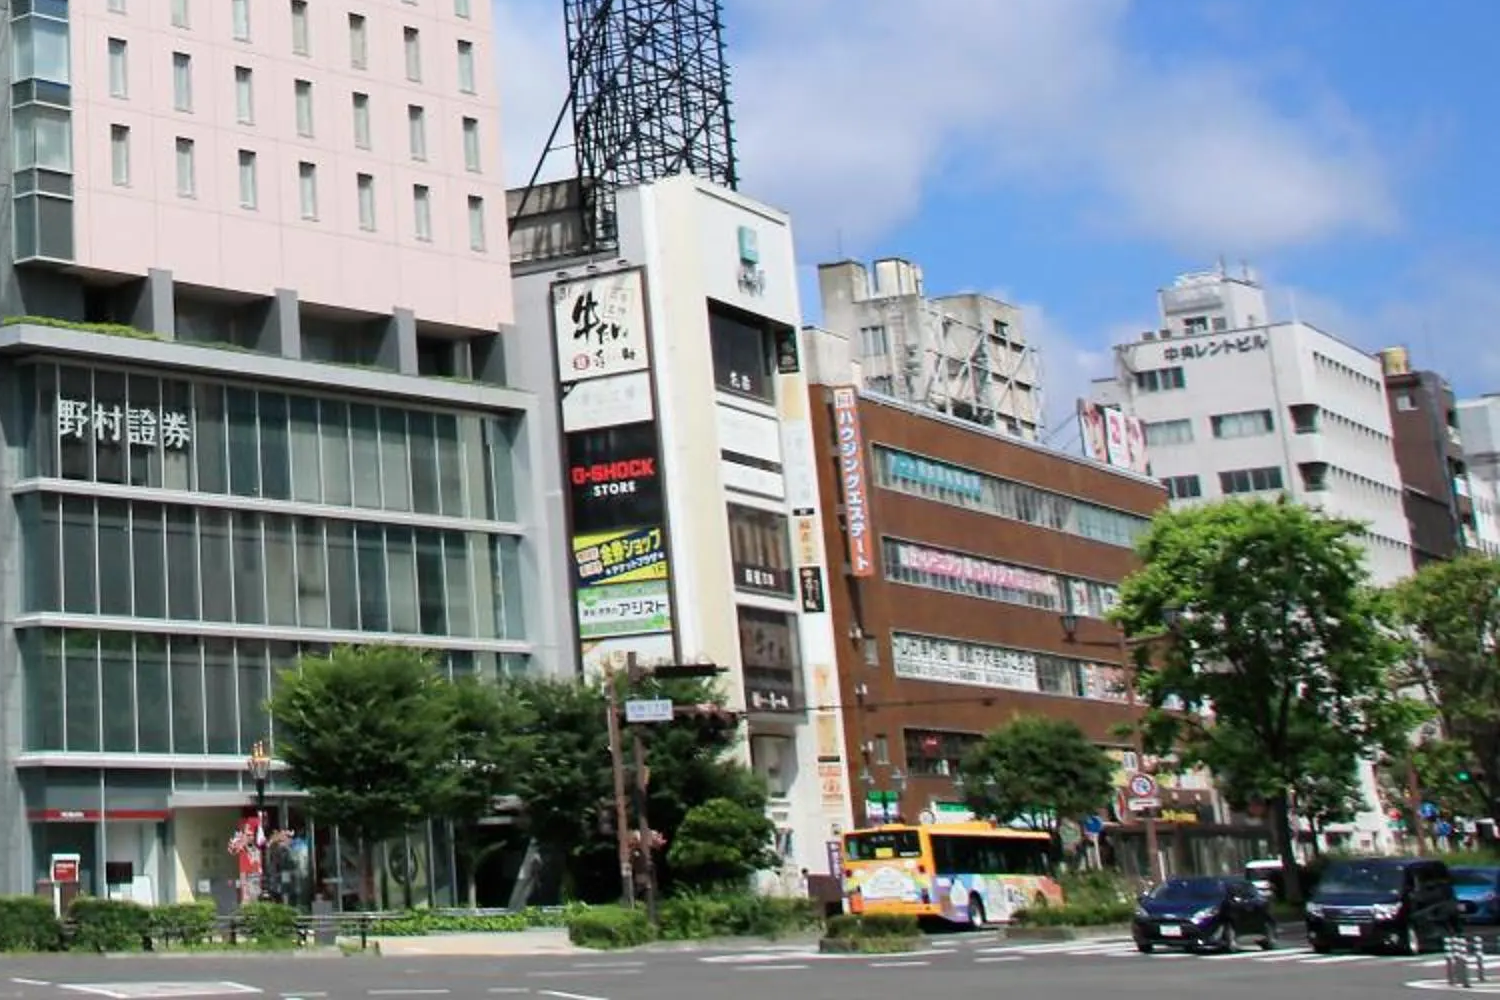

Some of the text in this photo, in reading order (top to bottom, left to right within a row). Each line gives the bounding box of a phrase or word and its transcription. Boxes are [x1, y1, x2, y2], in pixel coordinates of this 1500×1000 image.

[1163, 335, 1269, 361] 中央レントビル
[57, 399, 192, 449] 野村證券
[572, 458, 655, 484] G-SHOCK
[593, 482, 637, 497] STORE
